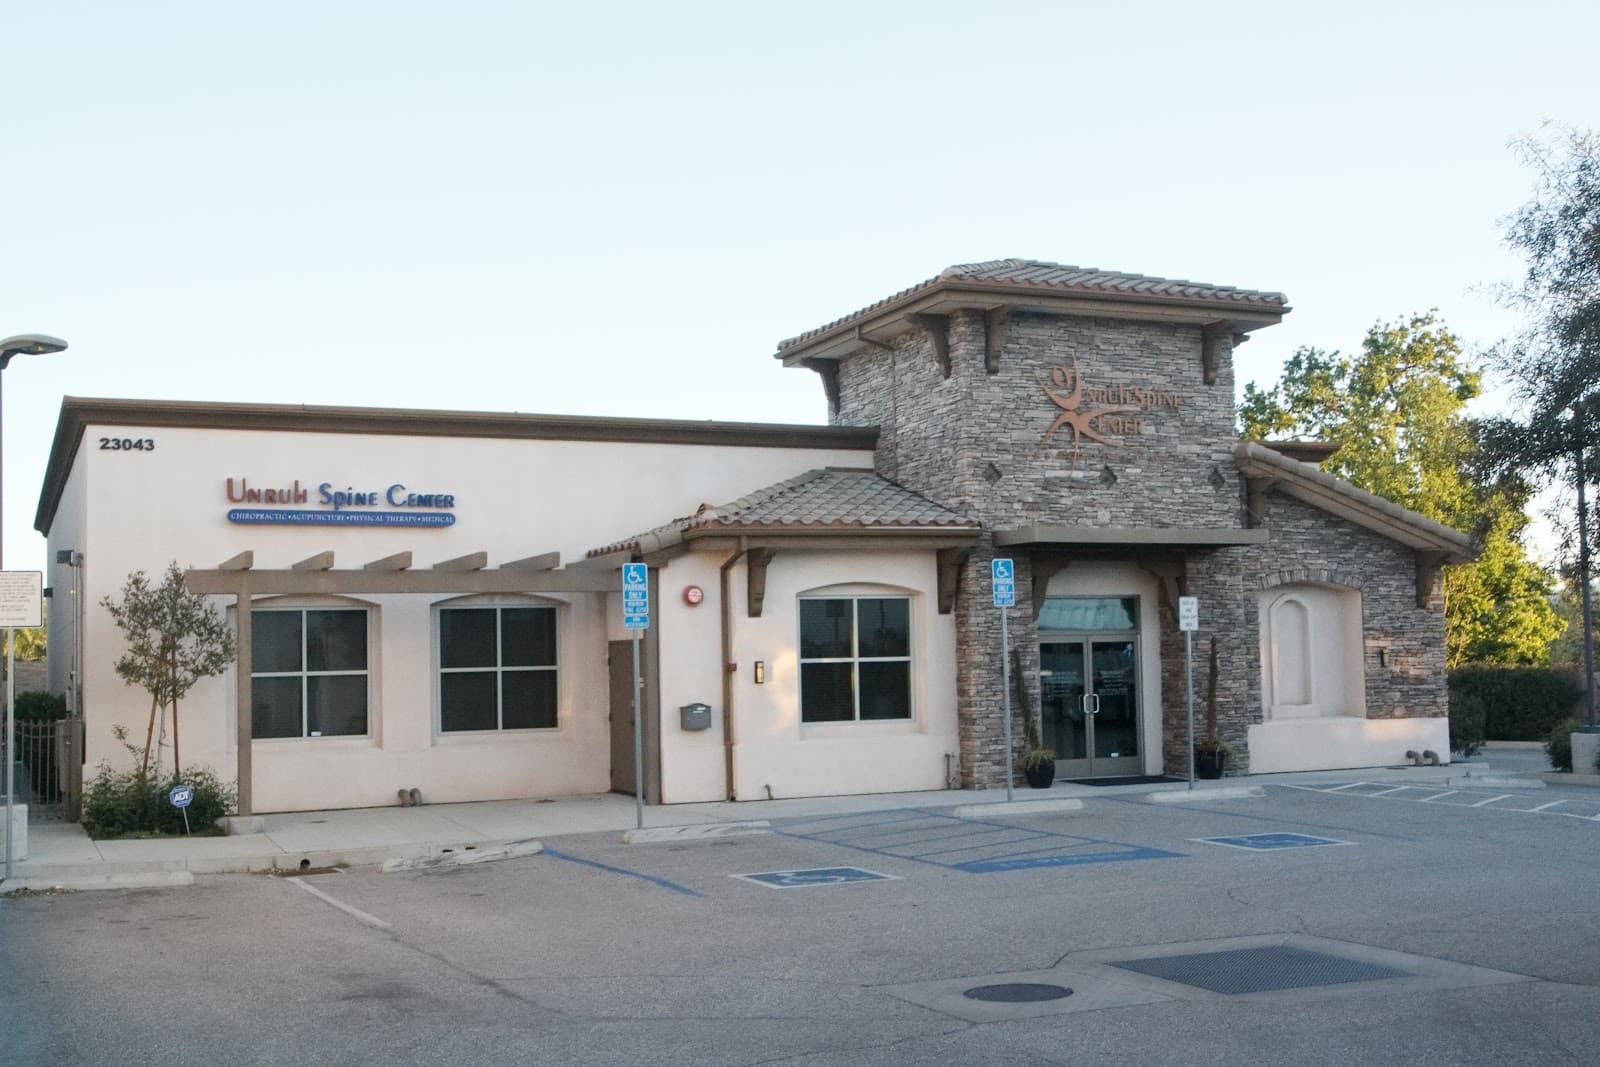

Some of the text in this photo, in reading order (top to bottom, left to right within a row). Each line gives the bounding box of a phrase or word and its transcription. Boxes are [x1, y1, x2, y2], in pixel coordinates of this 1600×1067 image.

[99, 437, 155, 451] 23043
[226, 477, 455, 510] UNRUh SpiNE CENTER
[230, 511, 454, 524] CHIROPRACTIC ACUPUNCTURE PHYSICAL THERAPY MEDICAL
[174, 790, 189, 802] ADT
